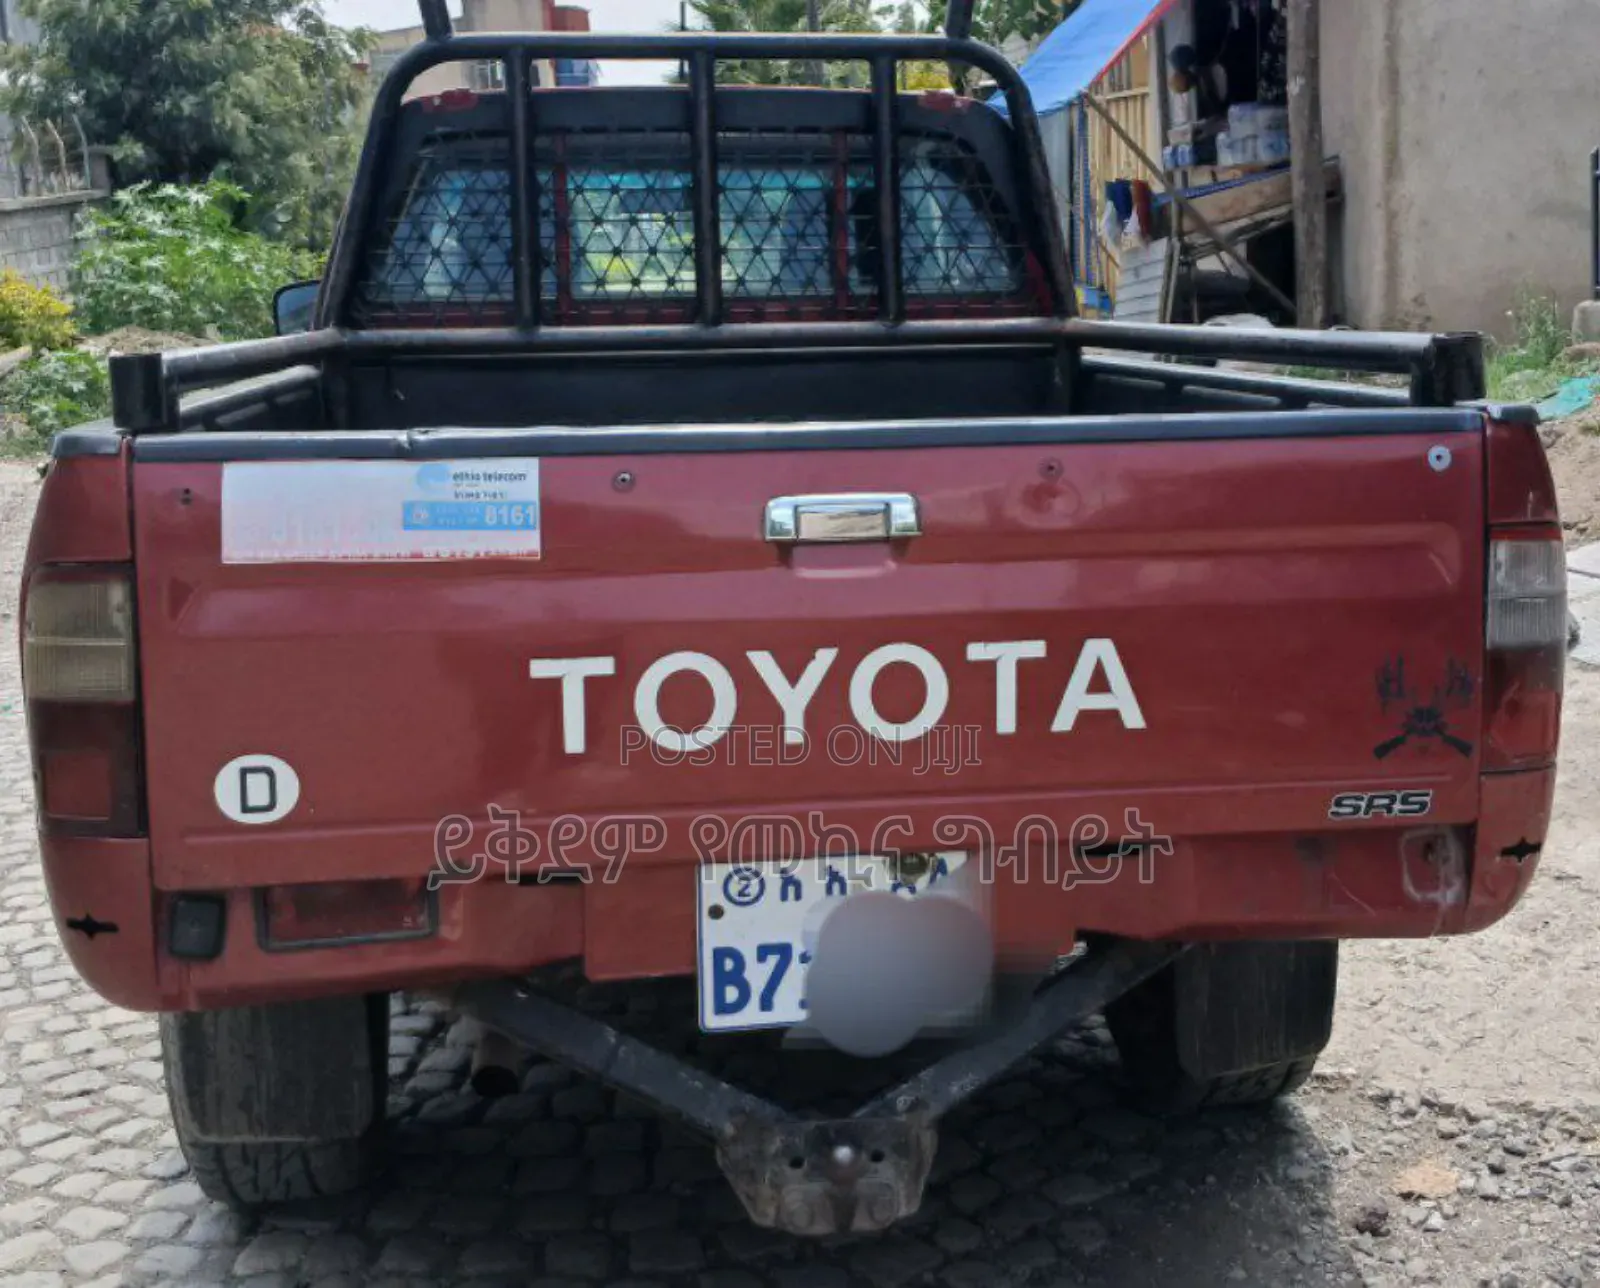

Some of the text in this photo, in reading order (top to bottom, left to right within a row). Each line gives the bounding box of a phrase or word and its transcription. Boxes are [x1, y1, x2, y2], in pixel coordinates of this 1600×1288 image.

[530, 638, 1147, 754] TOYOTA
[239, 765, 278, 814] D
[712, 942, 812, 1016] B7
